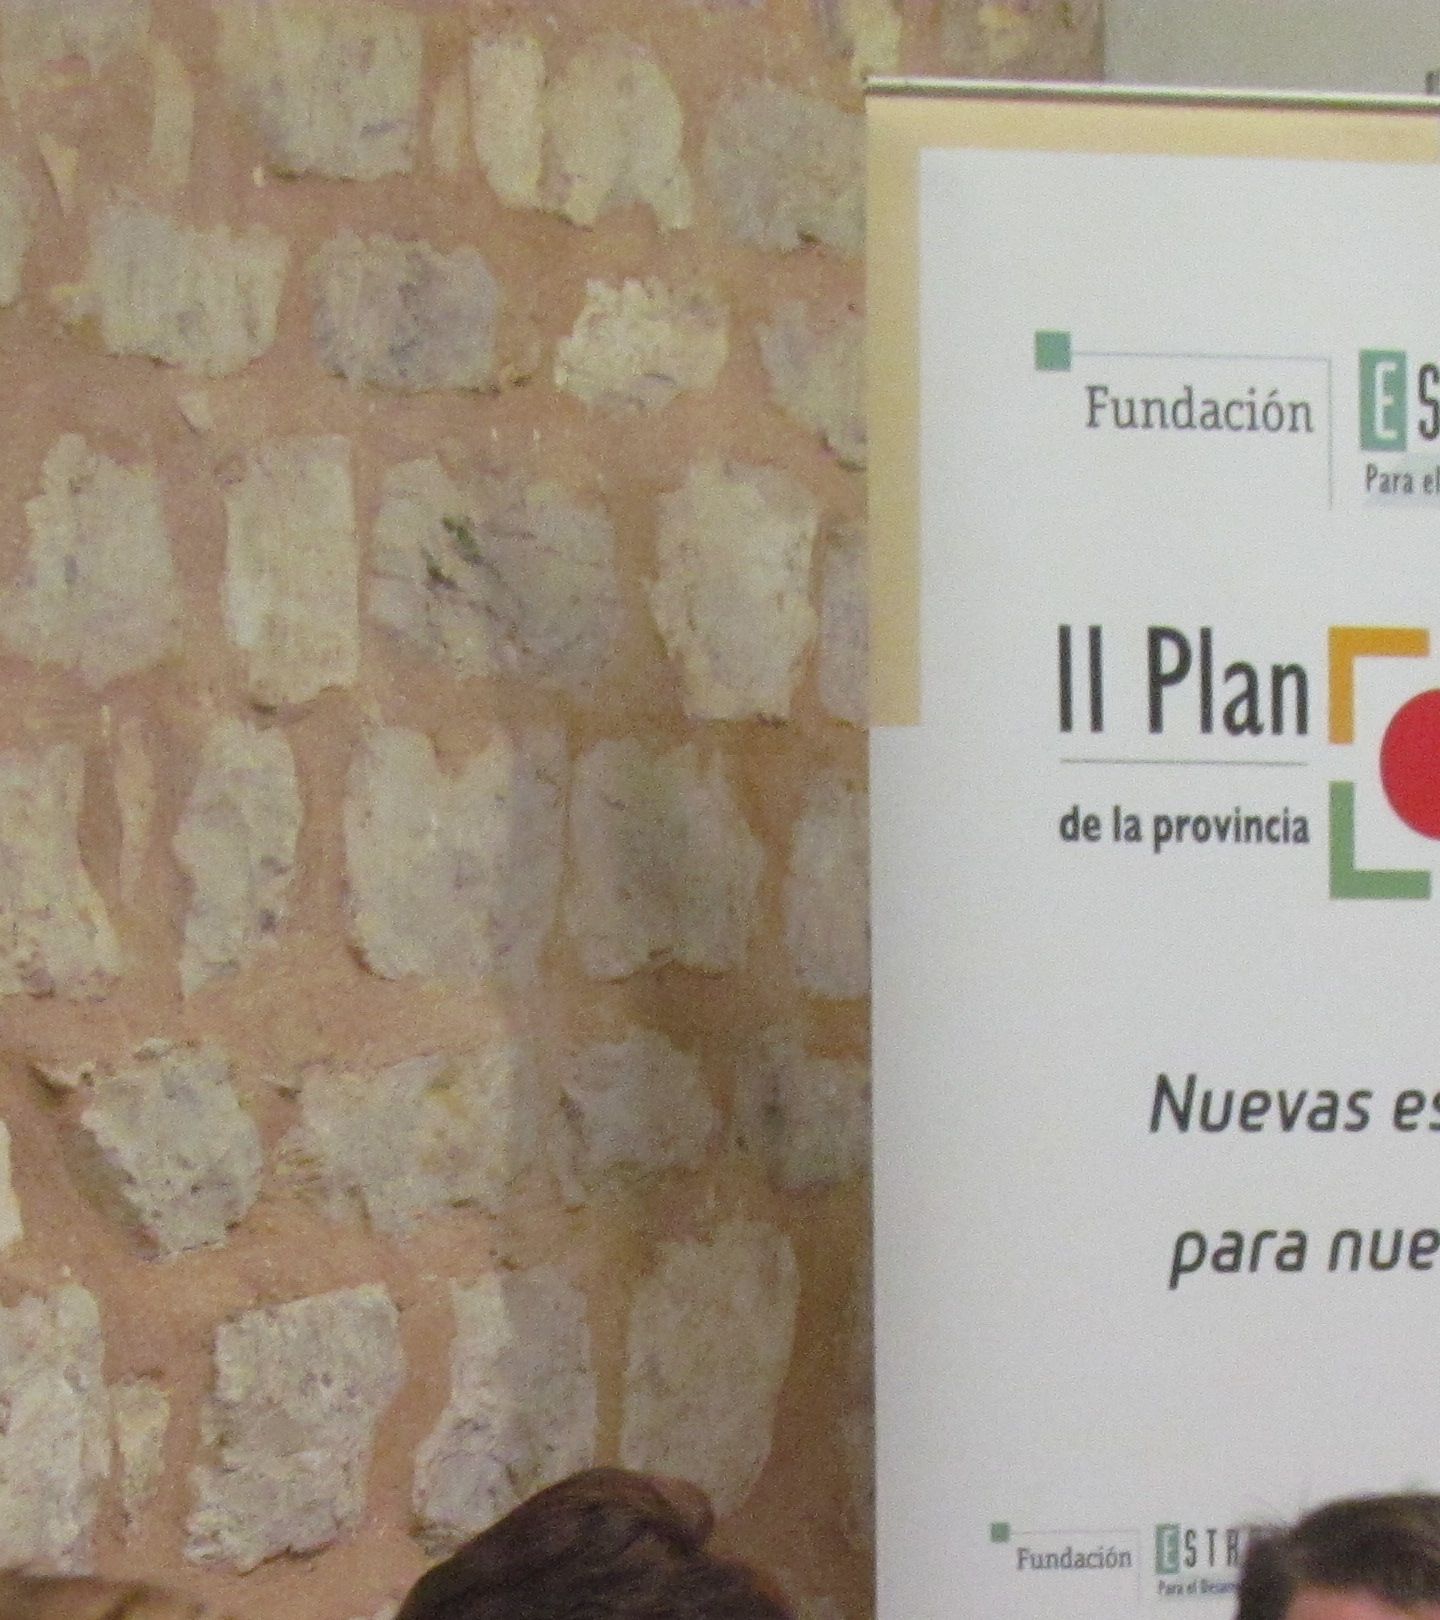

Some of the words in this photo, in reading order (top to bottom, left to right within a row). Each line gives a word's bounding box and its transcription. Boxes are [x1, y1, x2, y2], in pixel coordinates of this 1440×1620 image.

[1085, 384, 1314, 433] Fundación
[1365, 462, 1415, 495] Para
[1058, 625, 1104, 735] II
[1147, 625, 1310, 737] Plan
[1059, 805, 1102, 843] de
[1112, 806, 1143, 844] la
[1153, 807, 1310, 853] provincia
[1149, 1073, 1373, 1133] Nuevas
[1168, 1228, 1309, 1291] para
[1016, 1545, 1133, 1571] Fundación
[1165, 1528, 1241, 1568] ESTR
